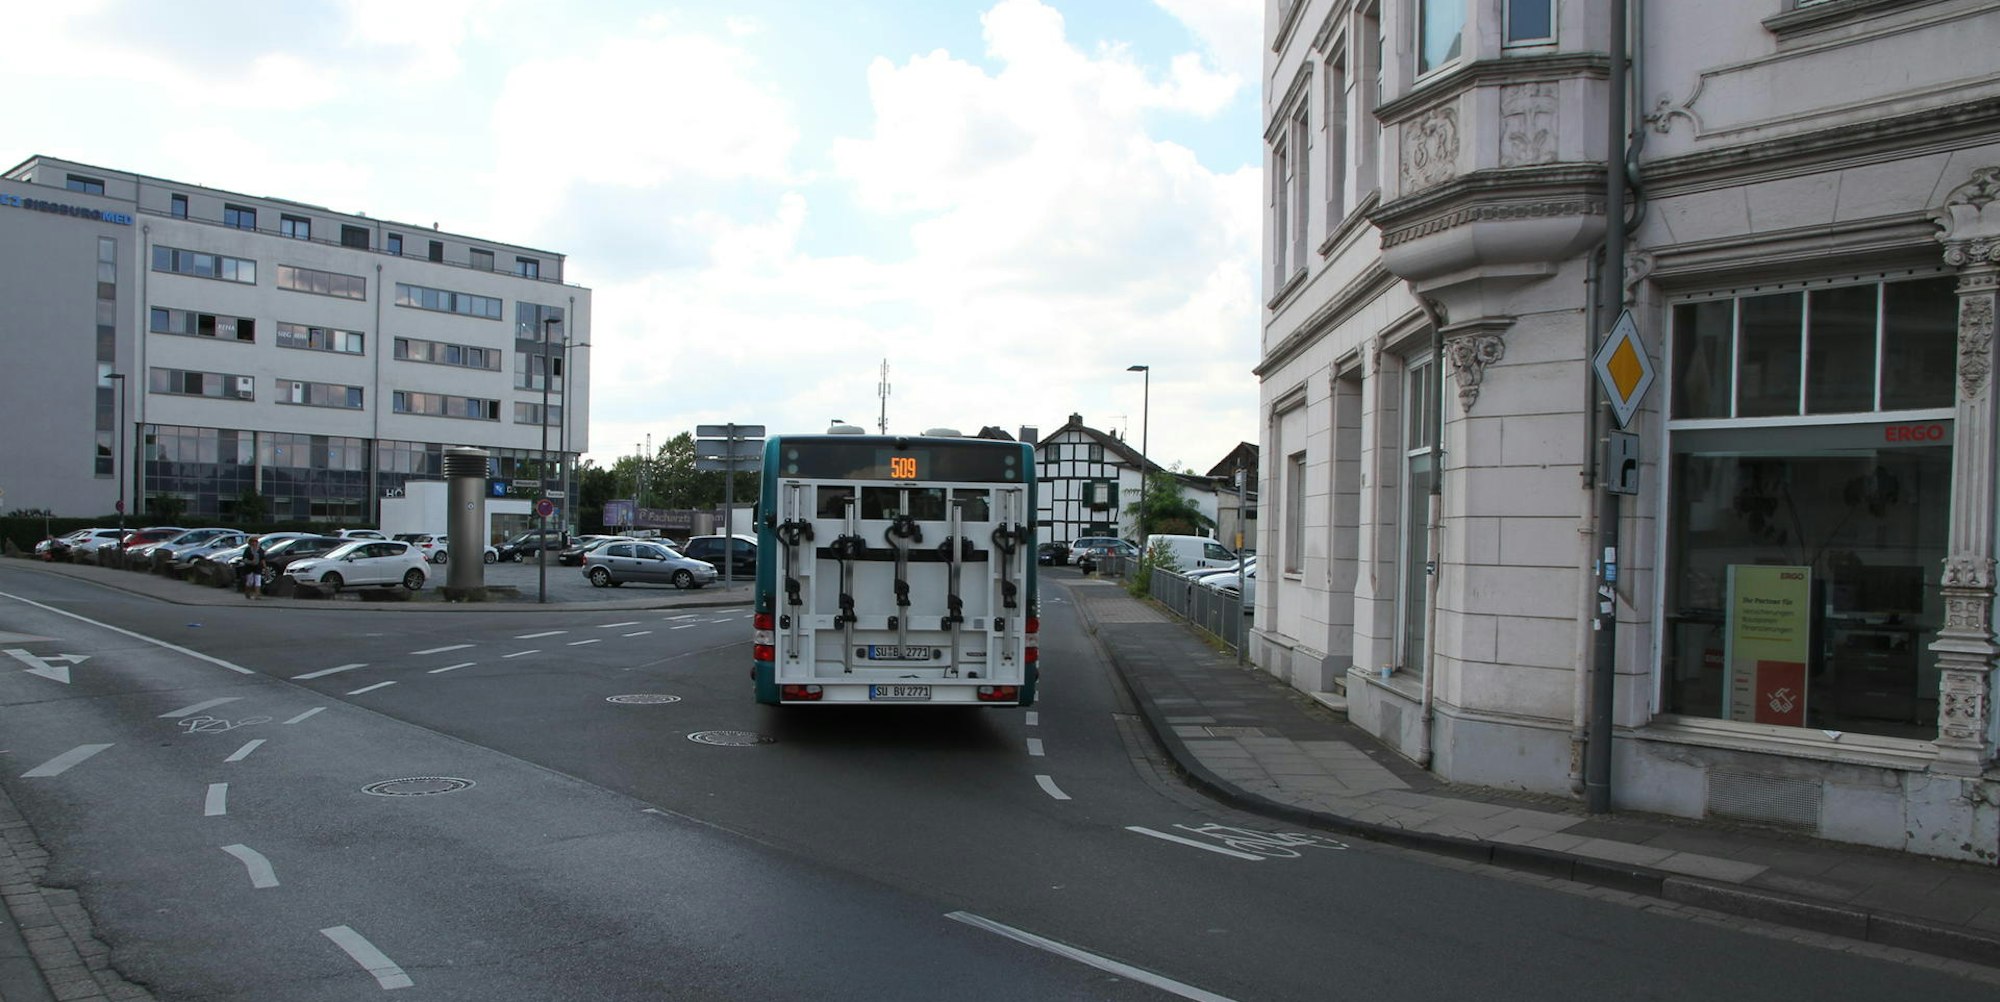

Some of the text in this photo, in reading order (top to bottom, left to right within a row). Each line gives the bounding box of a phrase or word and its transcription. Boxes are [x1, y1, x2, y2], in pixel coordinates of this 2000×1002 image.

[1885, 424, 1944, 442] ERGO
[891, 457, 917, 478] 509
[1780, 572, 1804, 580] ERGO
[875, 647, 887, 657] SU
[906, 647, 928, 657] 2771
[876, 686, 929, 697] SU BV 2771
